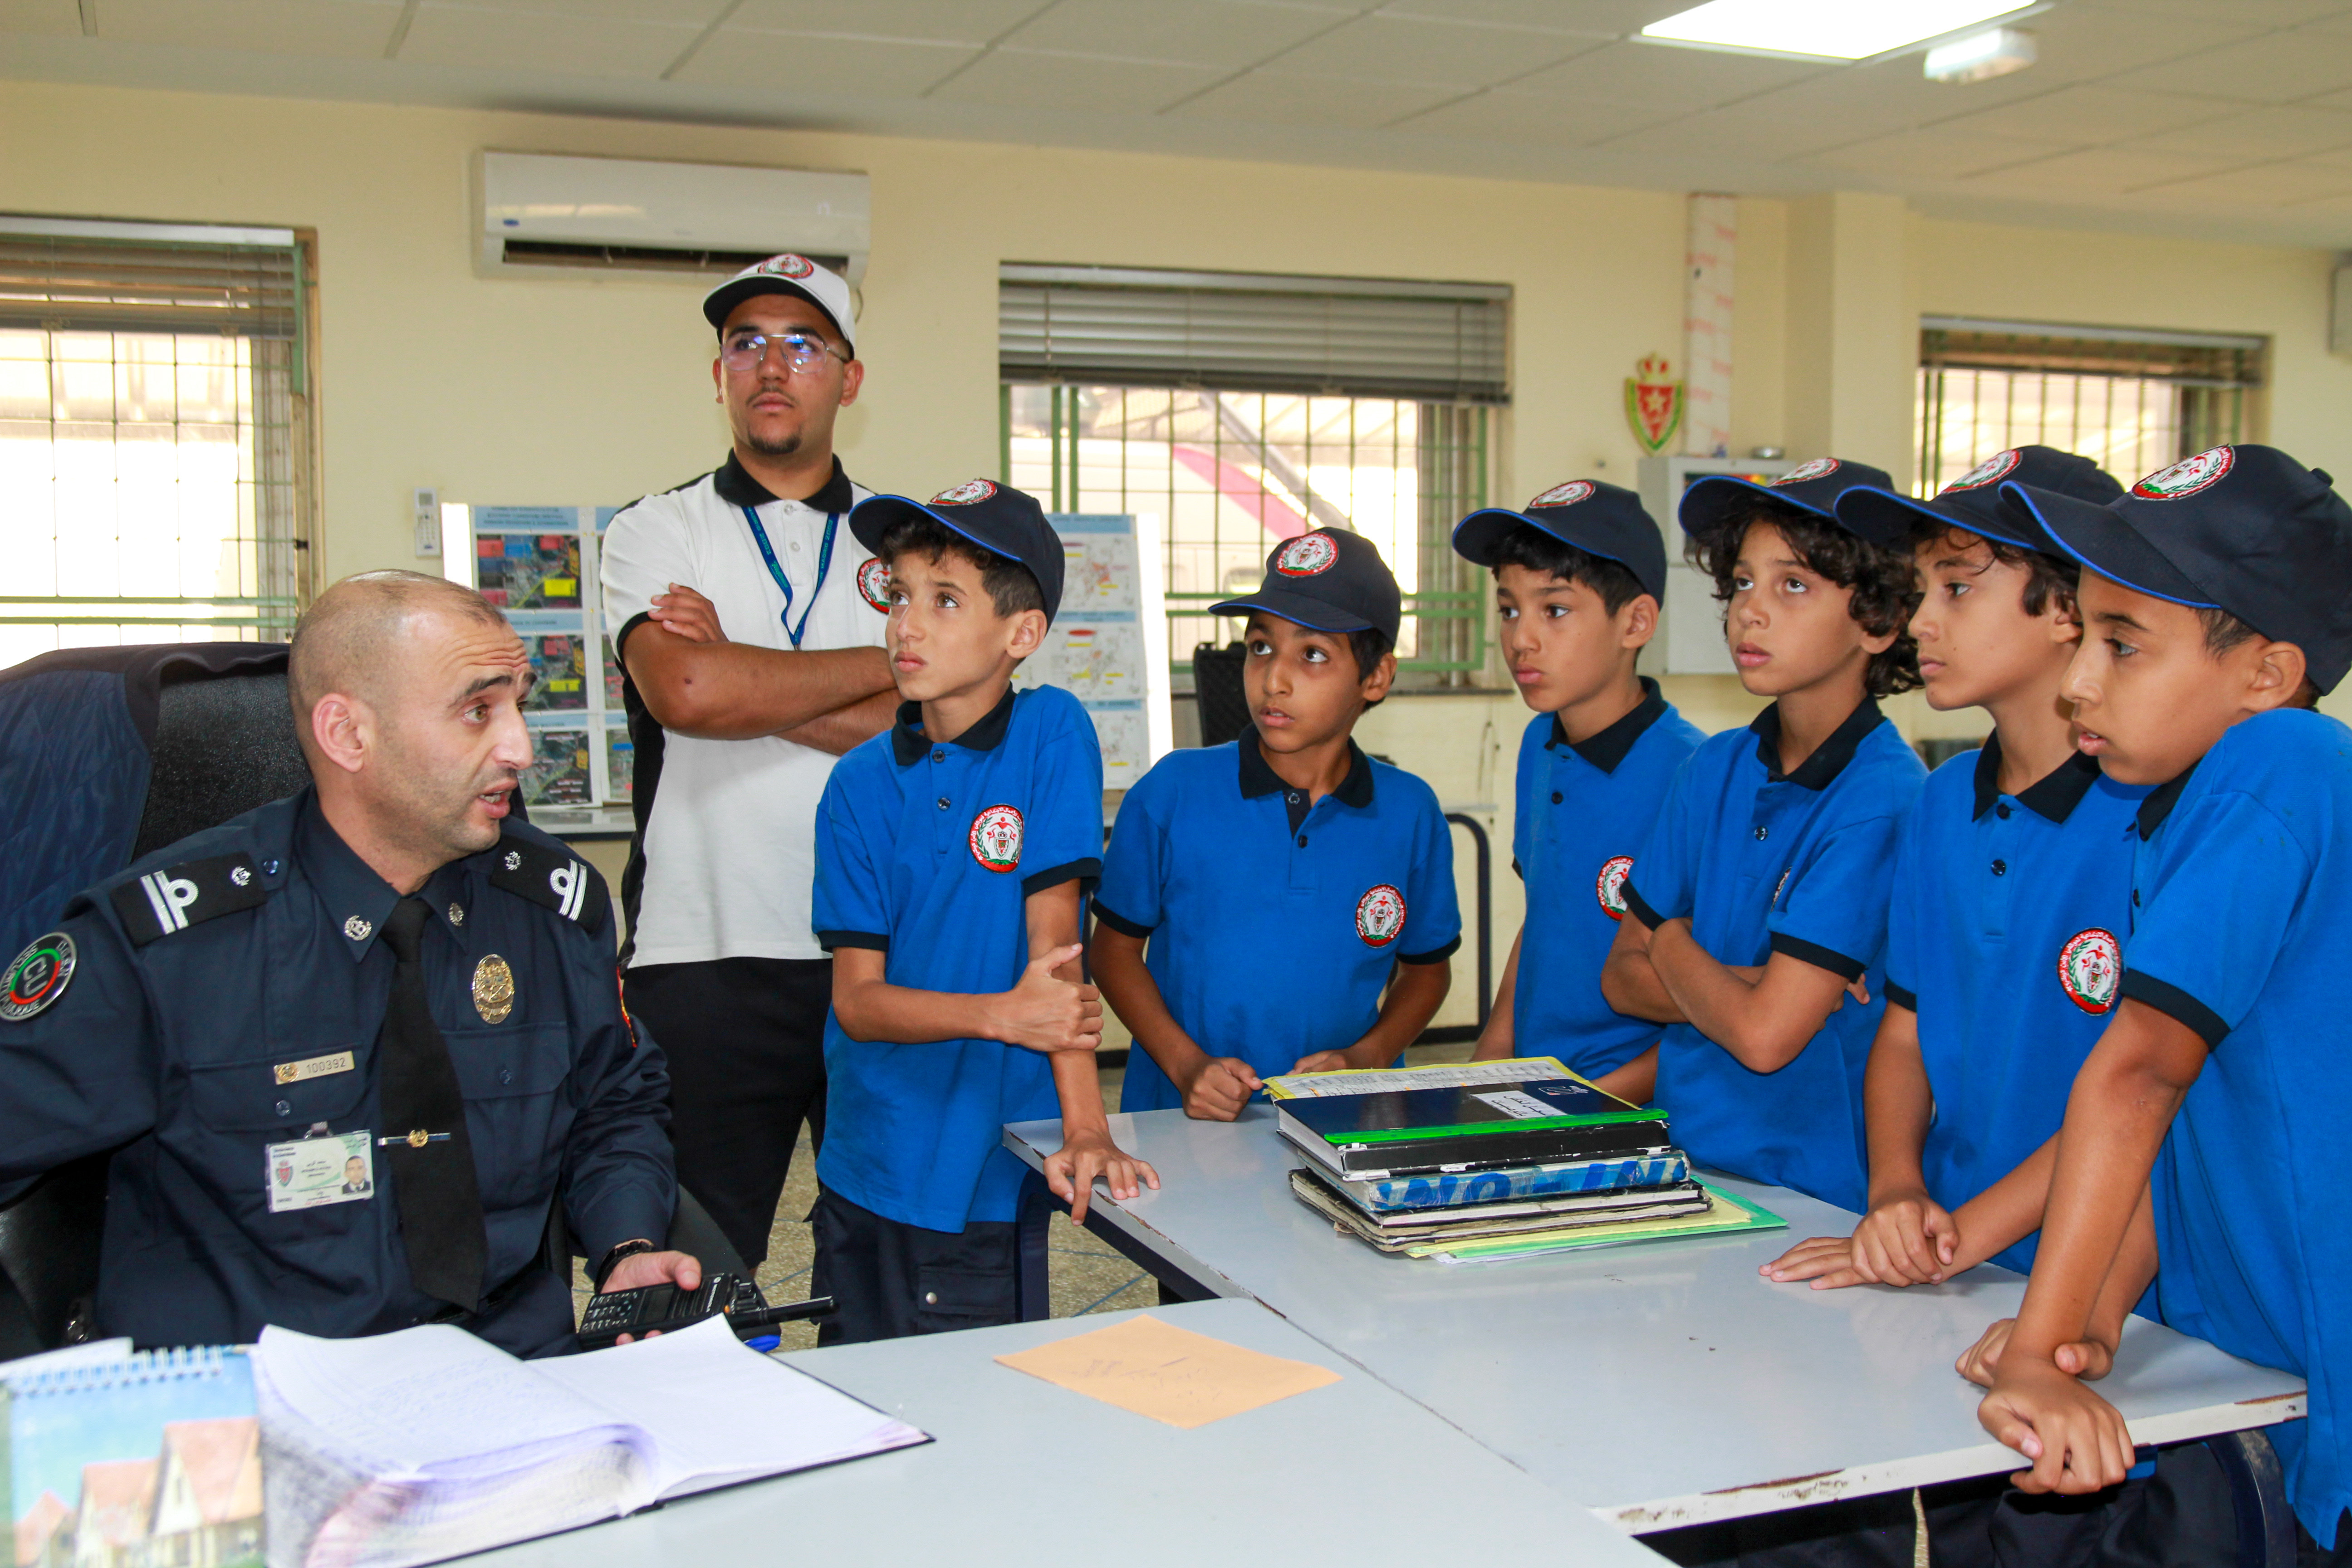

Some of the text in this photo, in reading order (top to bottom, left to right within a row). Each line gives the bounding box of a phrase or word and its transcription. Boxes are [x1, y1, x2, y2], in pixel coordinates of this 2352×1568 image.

[825, 519, 833, 541] 2003
[759, 533, 771, 555] 2003
[23, 956, 49, 996] CU
[307, 1057, 346, 1074] 100392
